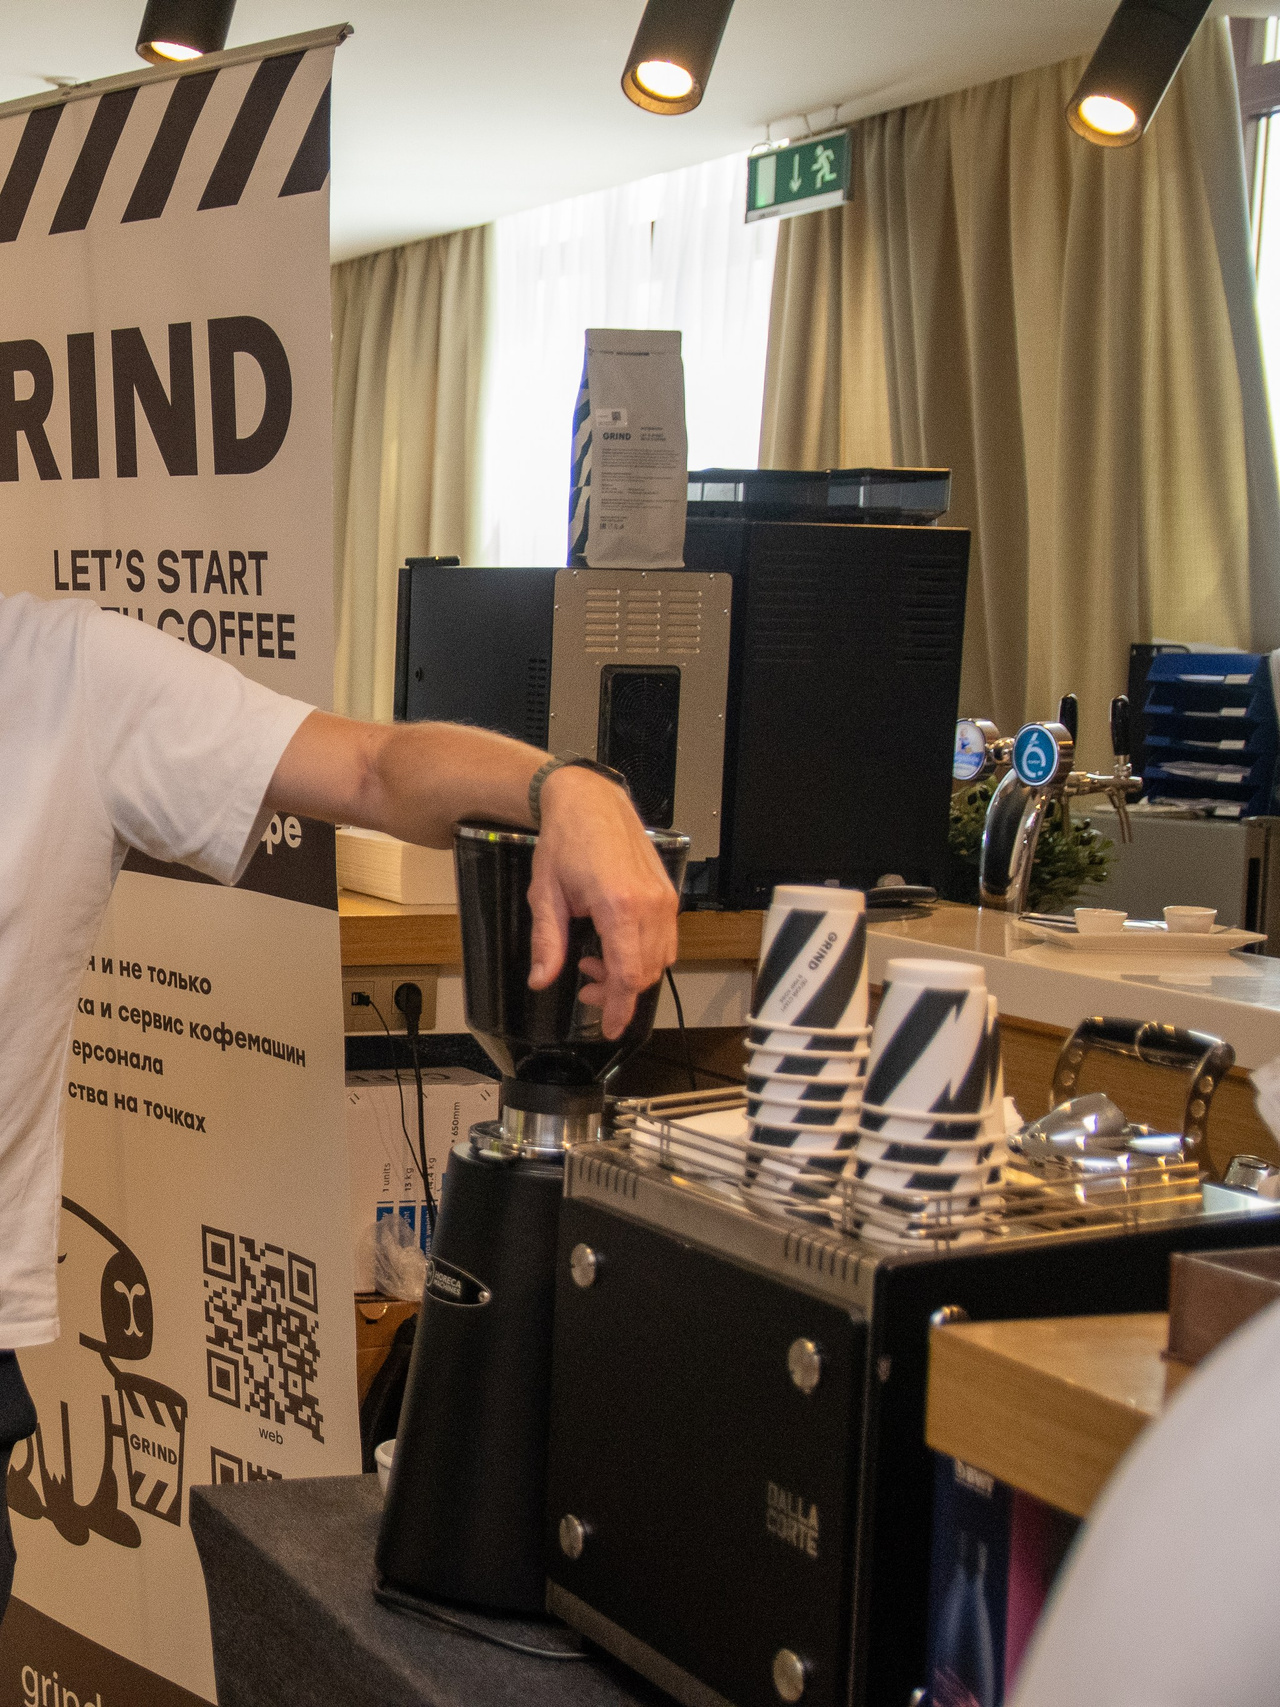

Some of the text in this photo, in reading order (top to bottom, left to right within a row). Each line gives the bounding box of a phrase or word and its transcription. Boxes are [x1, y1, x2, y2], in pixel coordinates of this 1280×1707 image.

[602, 432, 632, 441] GRIND
[157, 549, 269, 596] START
[156, 608, 297, 660] COFFEE
[808, 932, 838, 970] GRIND
[102, 957, 114, 974] и
[119, 960, 143, 980] не
[147, 965, 212, 995] только
[100, 1001, 112, 1019] и
[118, 1005, 184, 1035] сервис
[189, 1021, 306, 1068] кофемашин
[72, 1039, 164, 1075] ерсонала
[68, 1081, 207, 1133] ства на точках
[452, 1101, 460, 1136] 650mm
[383, 1162, 391, 1186] units
[404, 1167, 414, 1191] 13 kg
[428, 1157, 436, 1170] kg
[433, 1279, 462, 1297] MACHINES
[434, 1270, 462, 1289] HORECA
[130, 1433, 178, 1465] GRIND
[258, 1427, 284, 1445] web
[767, 1481, 818, 1532] DALLA
[766, 1508, 818, 1558] CORTE
